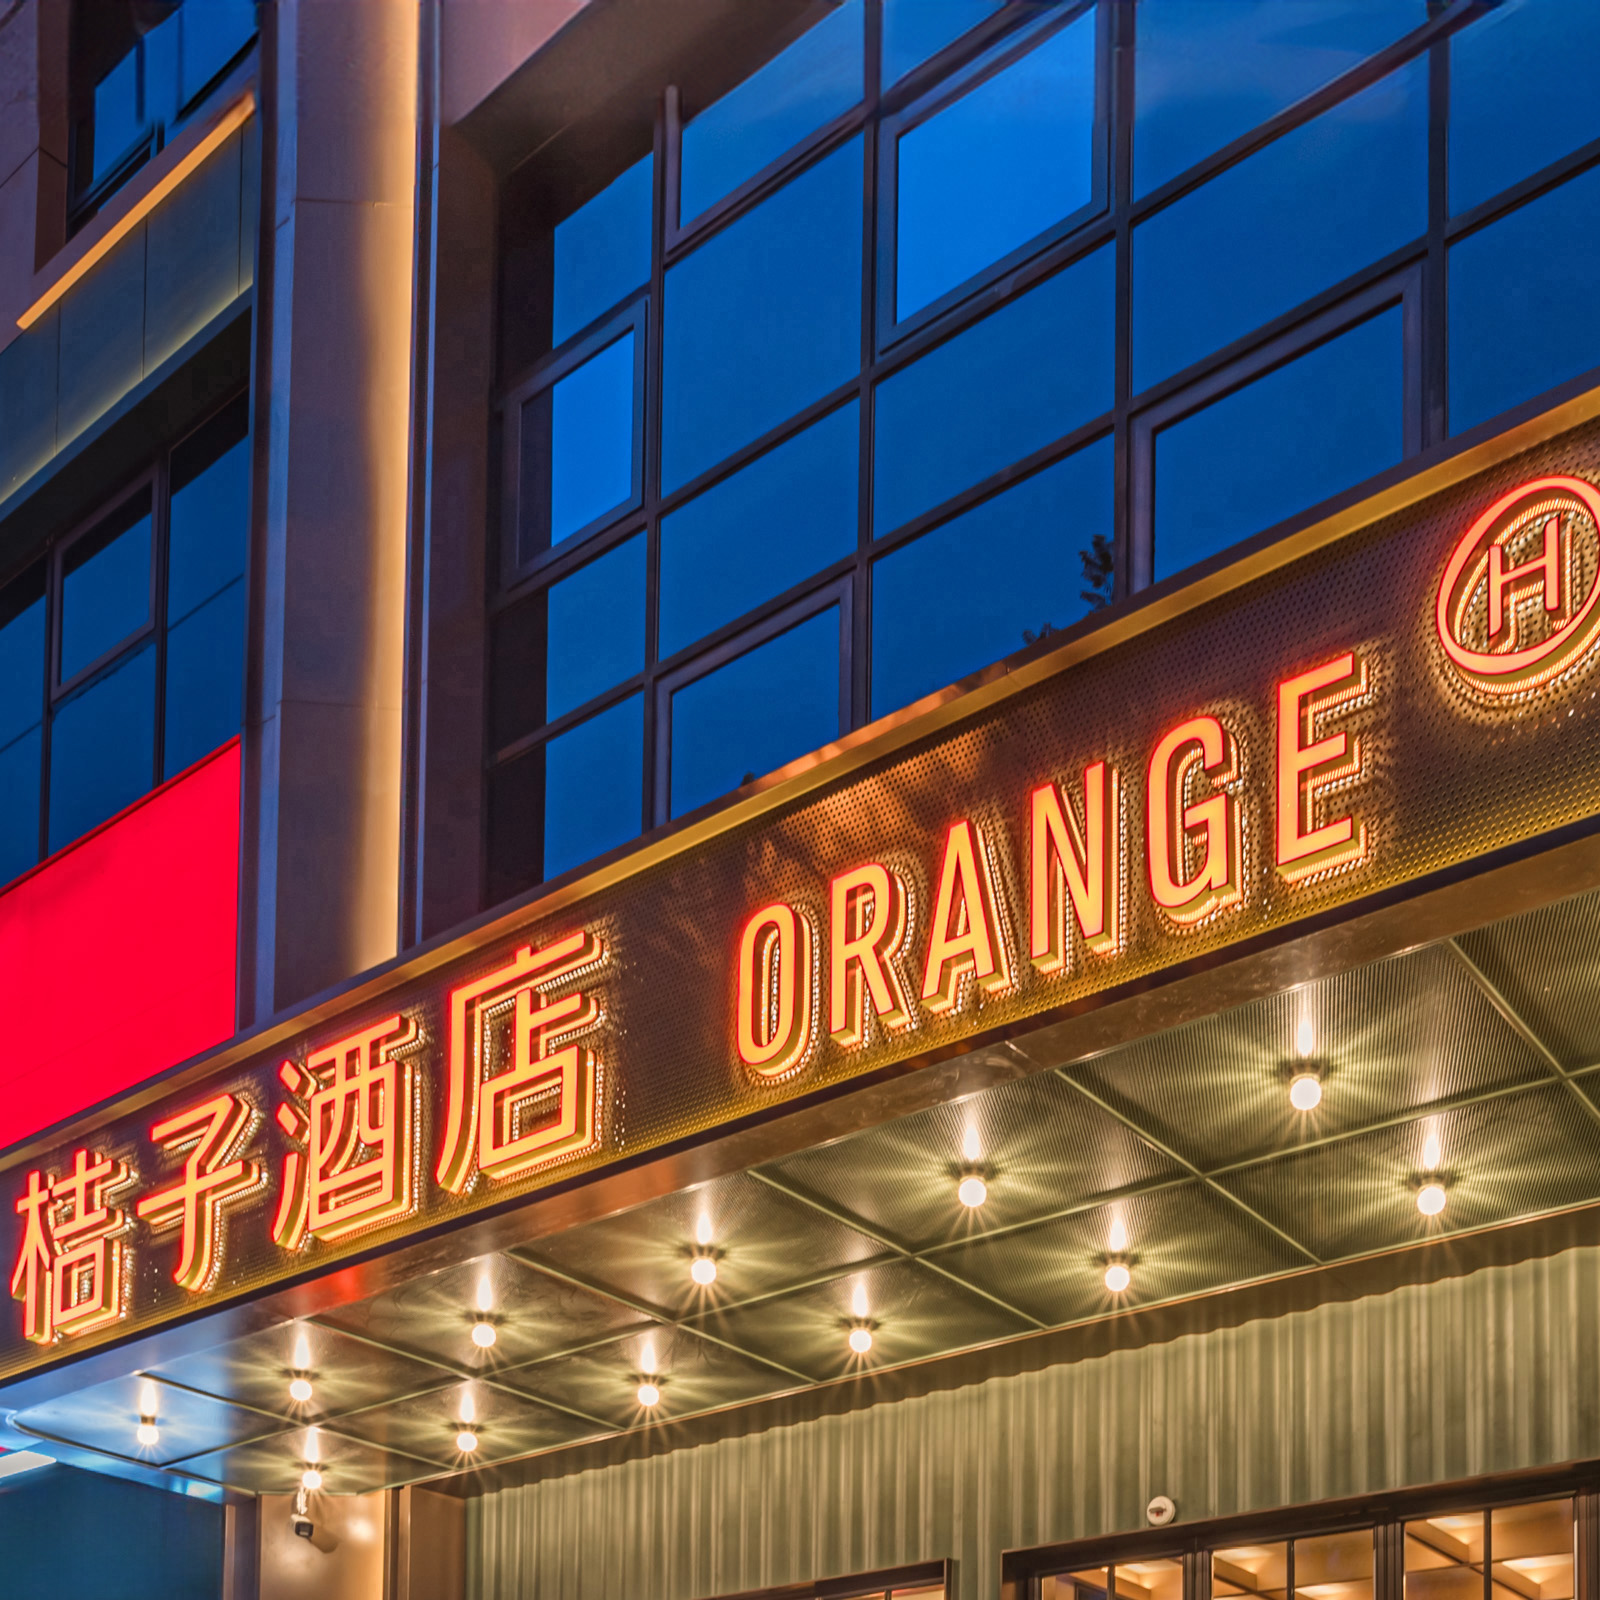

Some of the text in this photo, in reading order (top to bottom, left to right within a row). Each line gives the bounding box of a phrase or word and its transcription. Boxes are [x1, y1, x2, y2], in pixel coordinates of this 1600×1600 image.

[736, 652, 1367, 1075] ORANGE
[11, 930, 603, 1344] 桔子酒店
